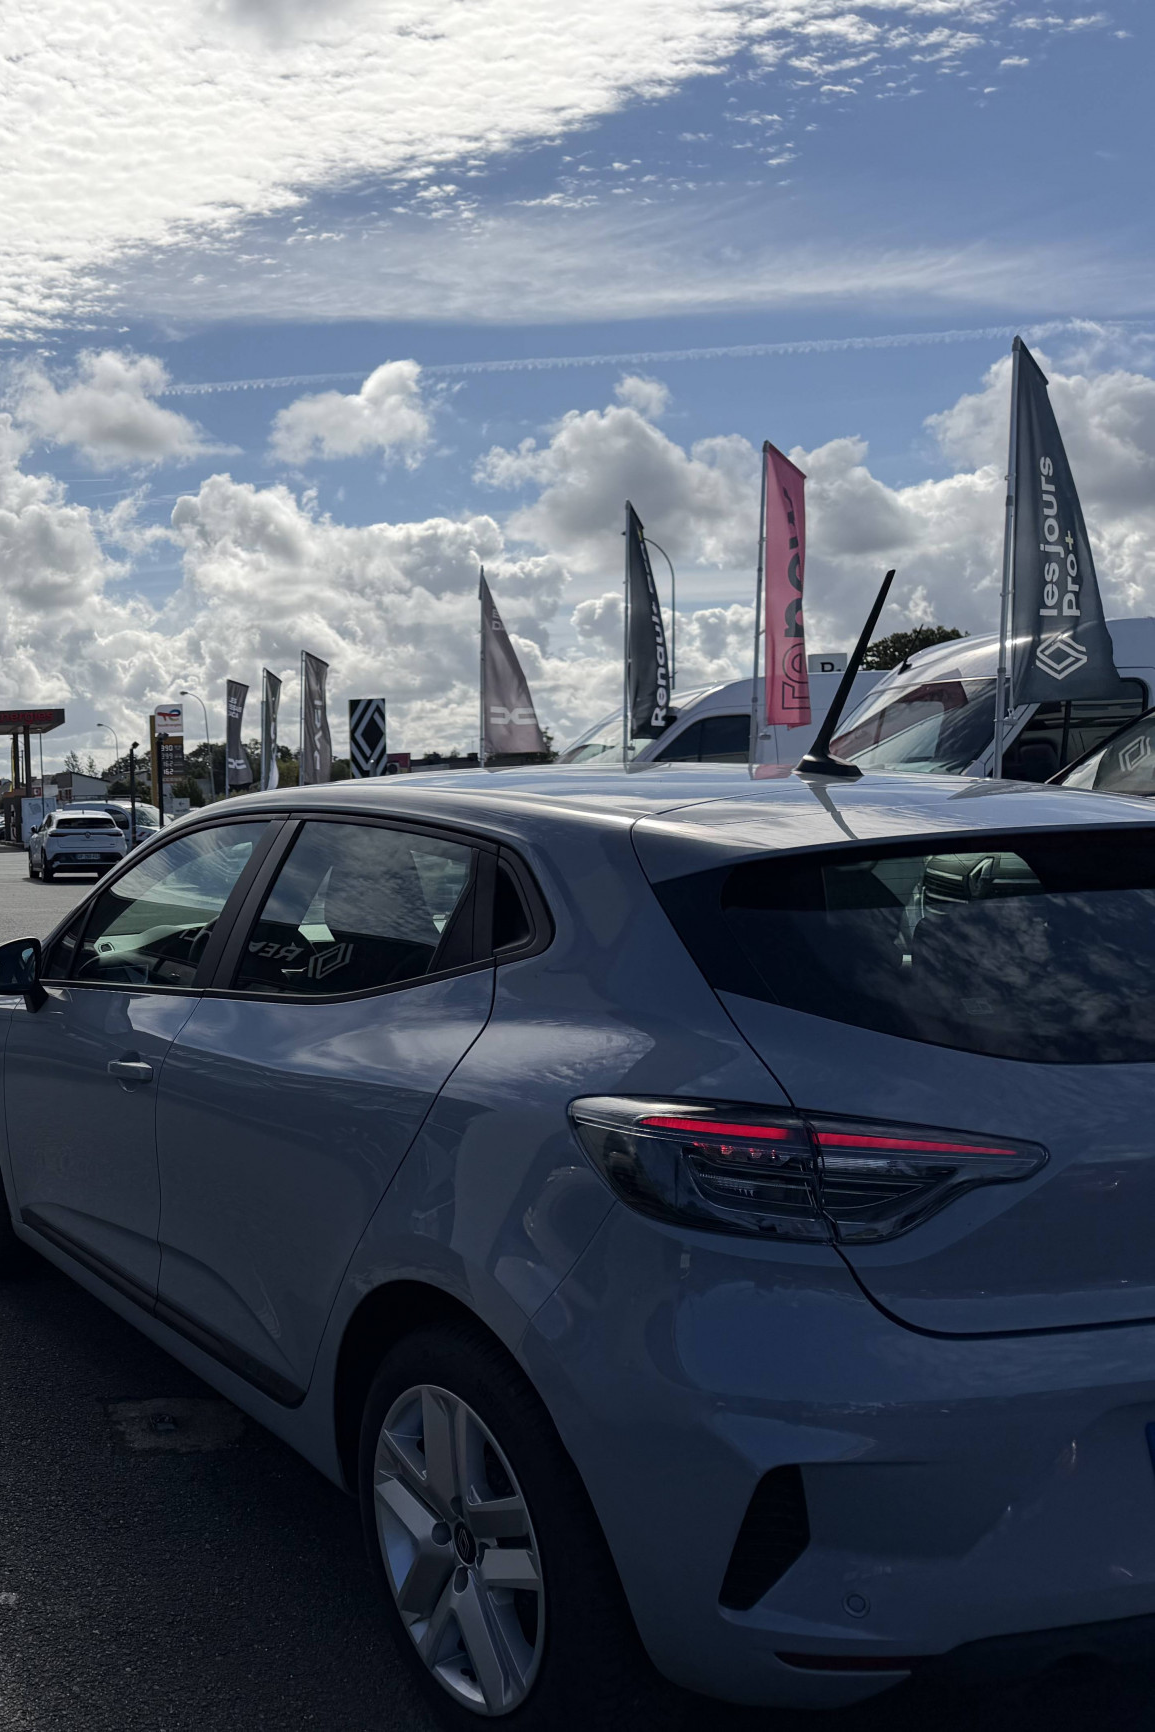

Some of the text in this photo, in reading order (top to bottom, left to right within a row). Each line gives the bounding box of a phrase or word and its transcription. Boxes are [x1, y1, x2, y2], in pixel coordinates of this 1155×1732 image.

[1039, 456, 1065, 617] les jours
[650, 601, 668, 727] Renault
